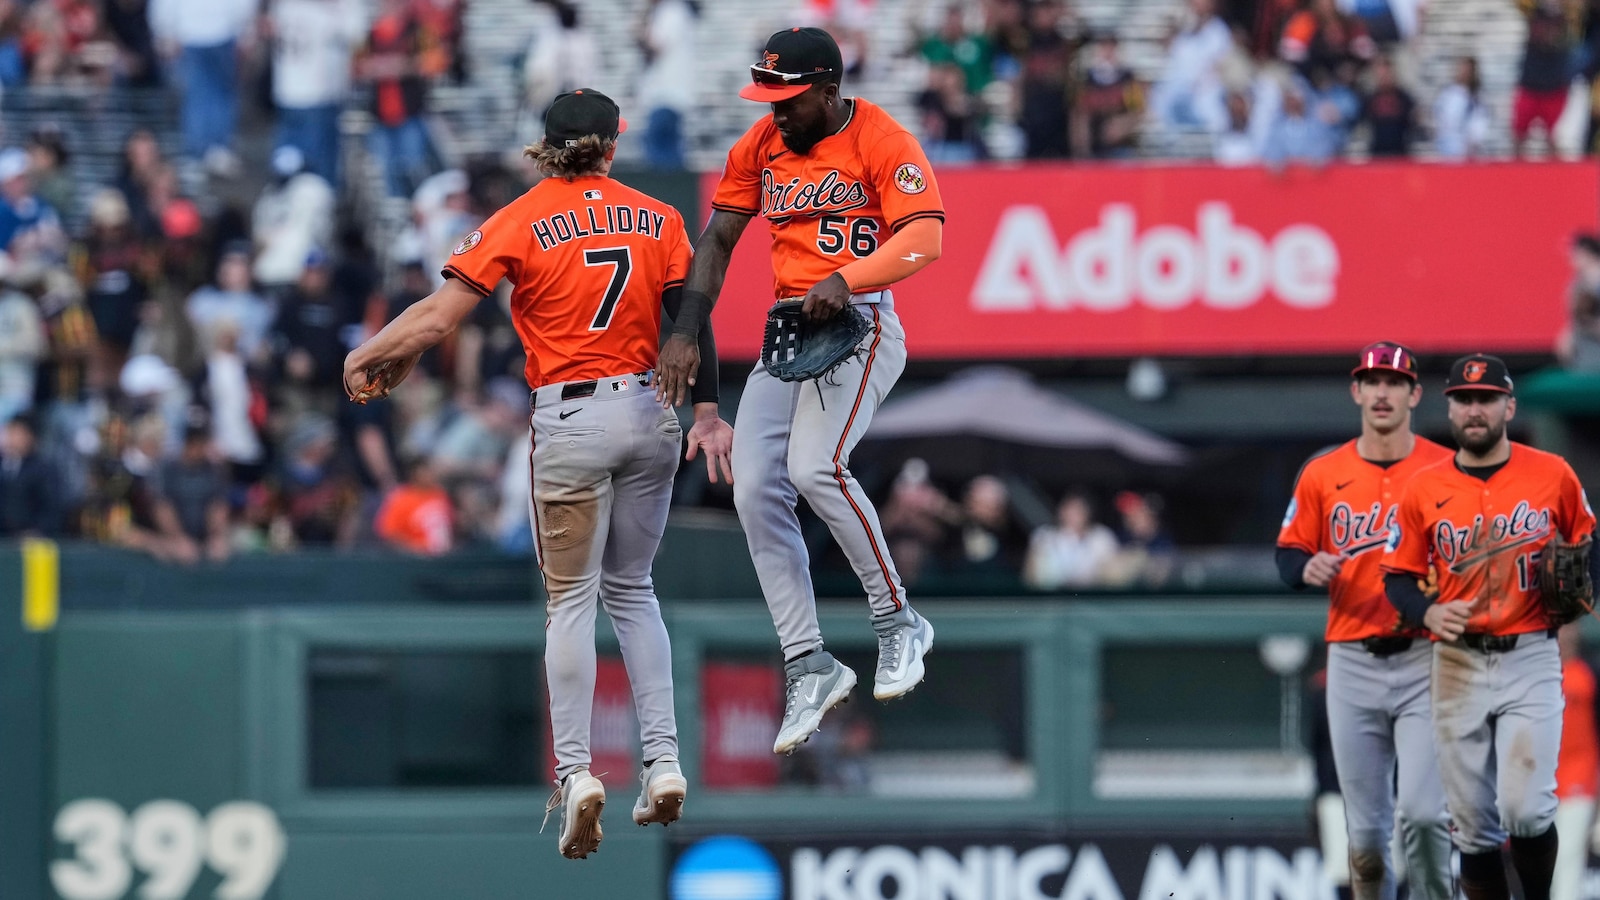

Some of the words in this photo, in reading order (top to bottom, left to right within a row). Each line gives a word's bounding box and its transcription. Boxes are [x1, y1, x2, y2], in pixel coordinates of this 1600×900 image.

[761, 168, 868, 218] Orioles
[531, 205, 666, 251] HOLLIDAY
[816, 215, 880, 259] 56
[971, 202, 1340, 311] Adobe
[583, 246, 633, 332] 7
[1434, 500, 1550, 564] Orioles
[49, 799, 286, 900] 399
[791, 845, 1124, 900] KONICA
[1138, 843, 1340, 900] MIN
